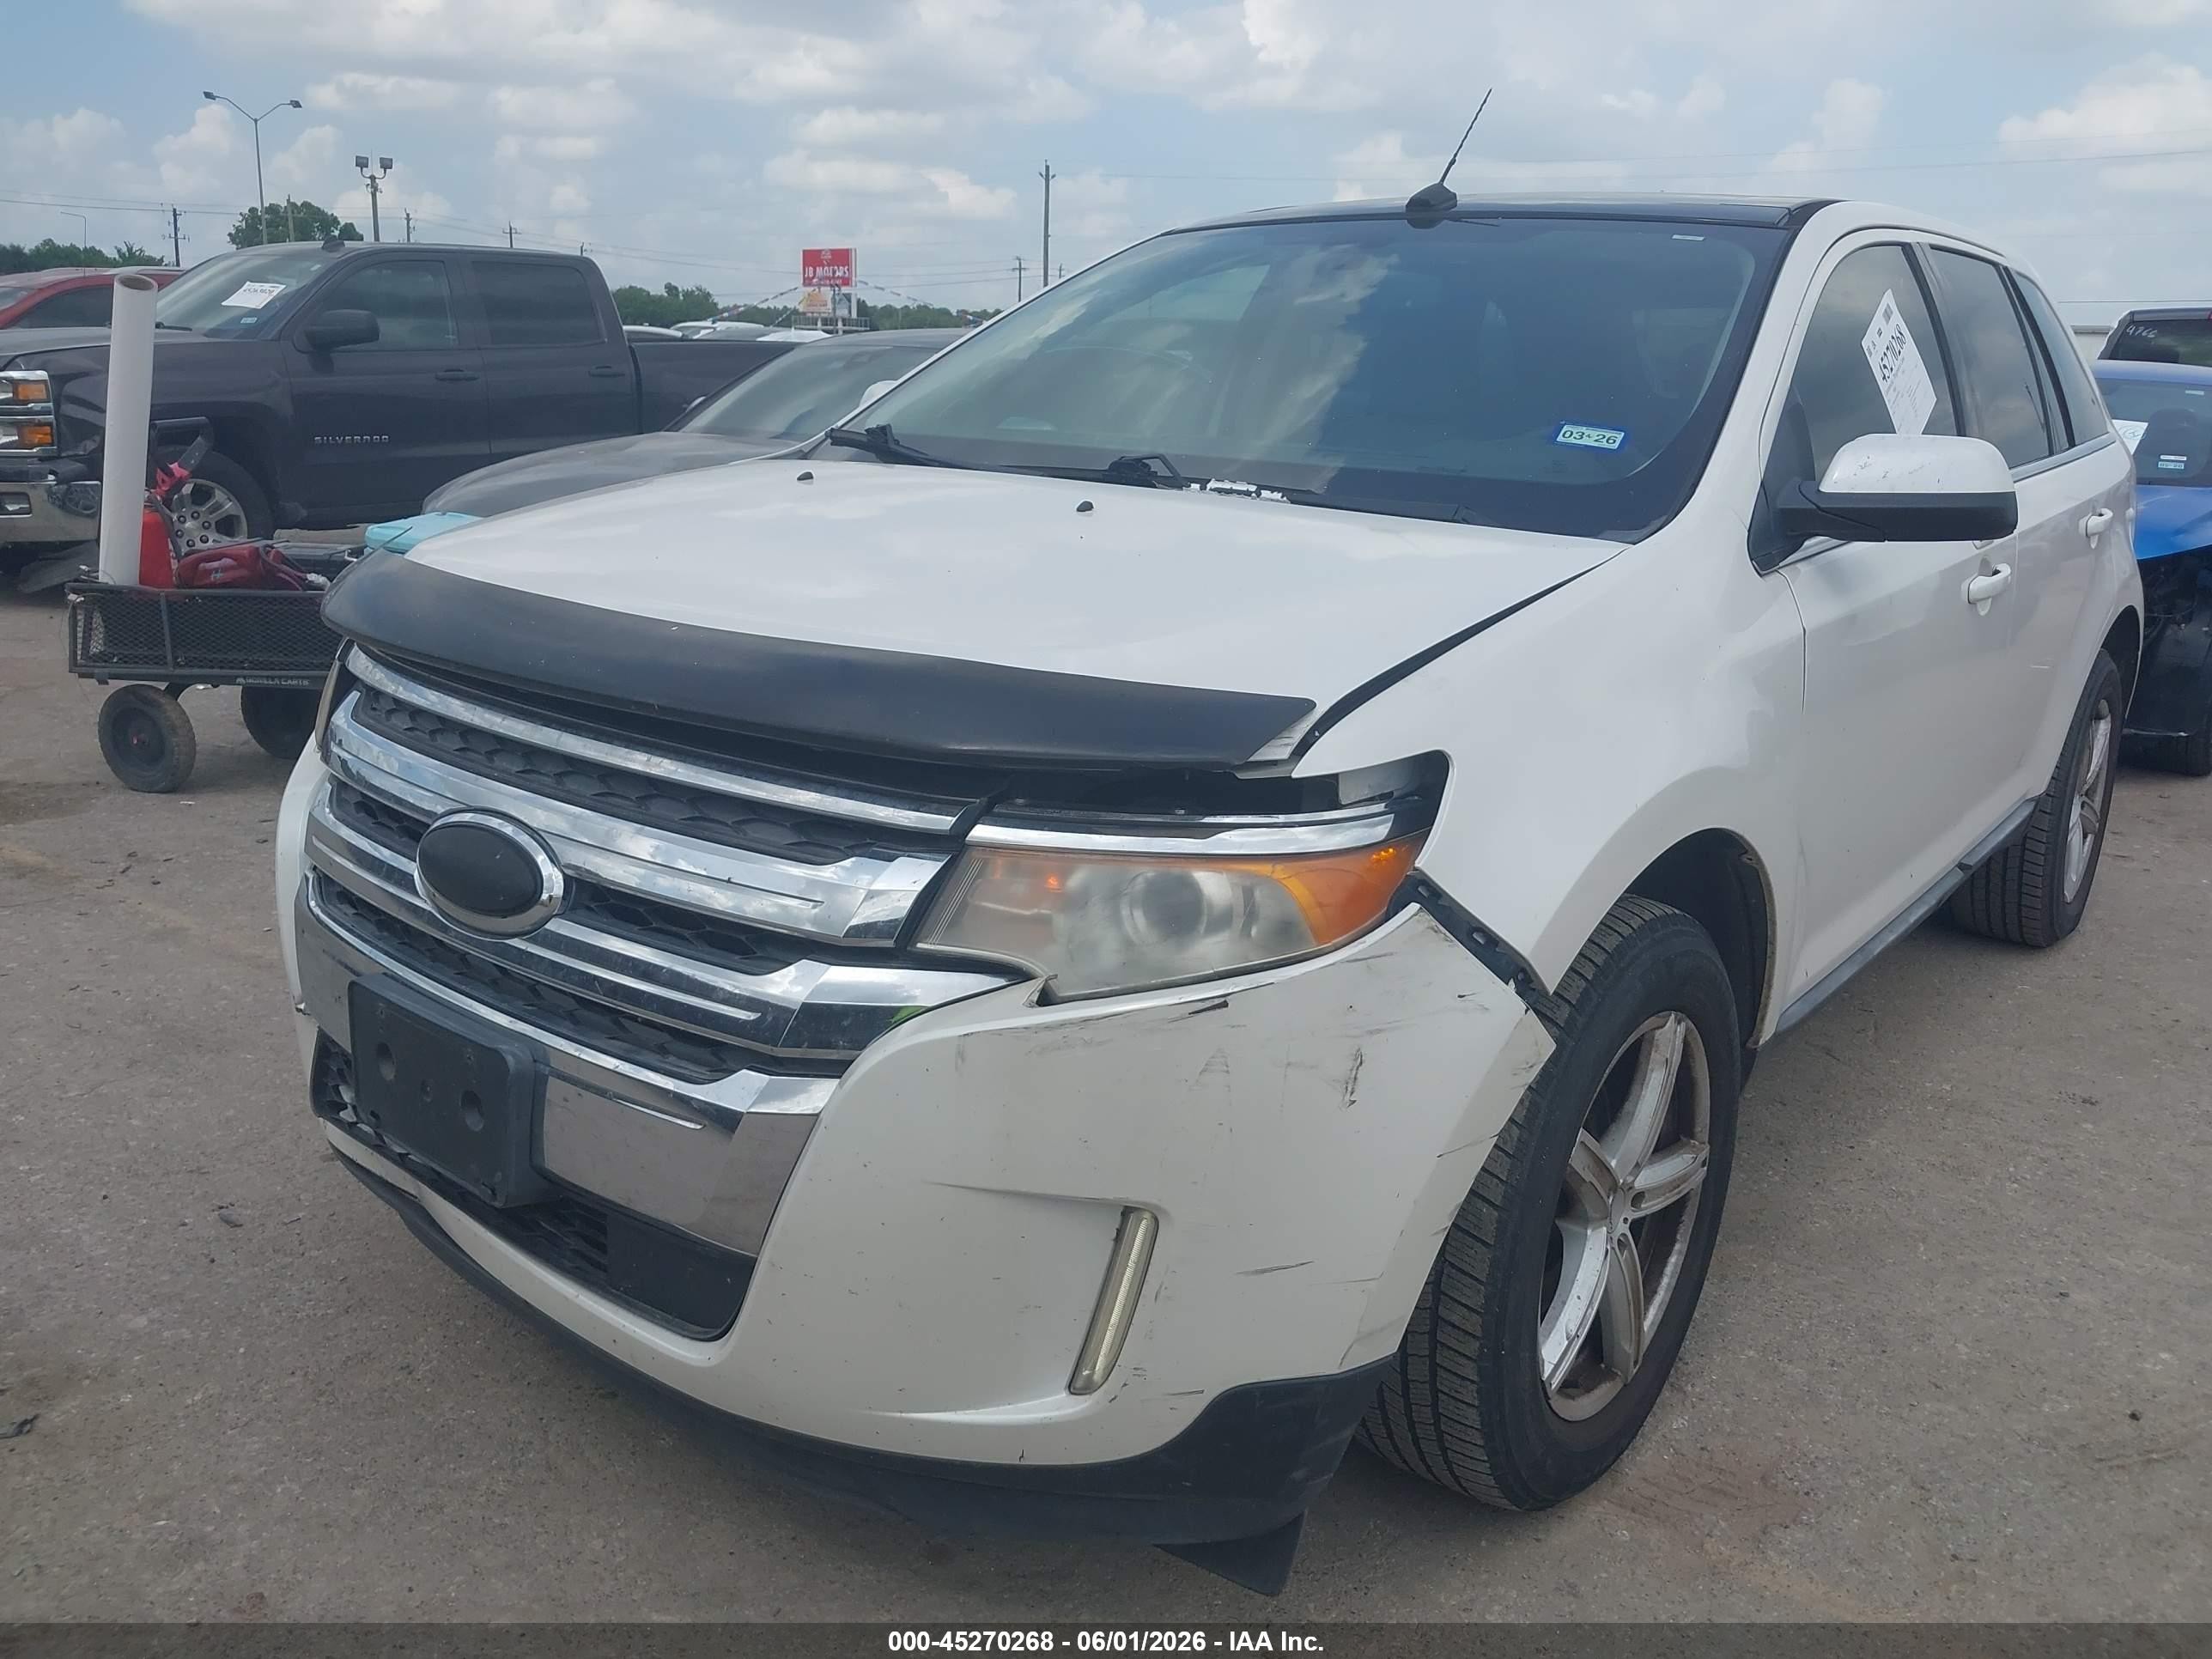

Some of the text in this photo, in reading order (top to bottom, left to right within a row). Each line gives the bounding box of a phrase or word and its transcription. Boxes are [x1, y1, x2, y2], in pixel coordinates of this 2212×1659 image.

[805, 265, 848, 277] JB MOTORS
[1879, 324, 1906, 383] 45270268
[314, 435, 389, 444] SILVERADO
[1562, 430, 1618, 445] 03 26
